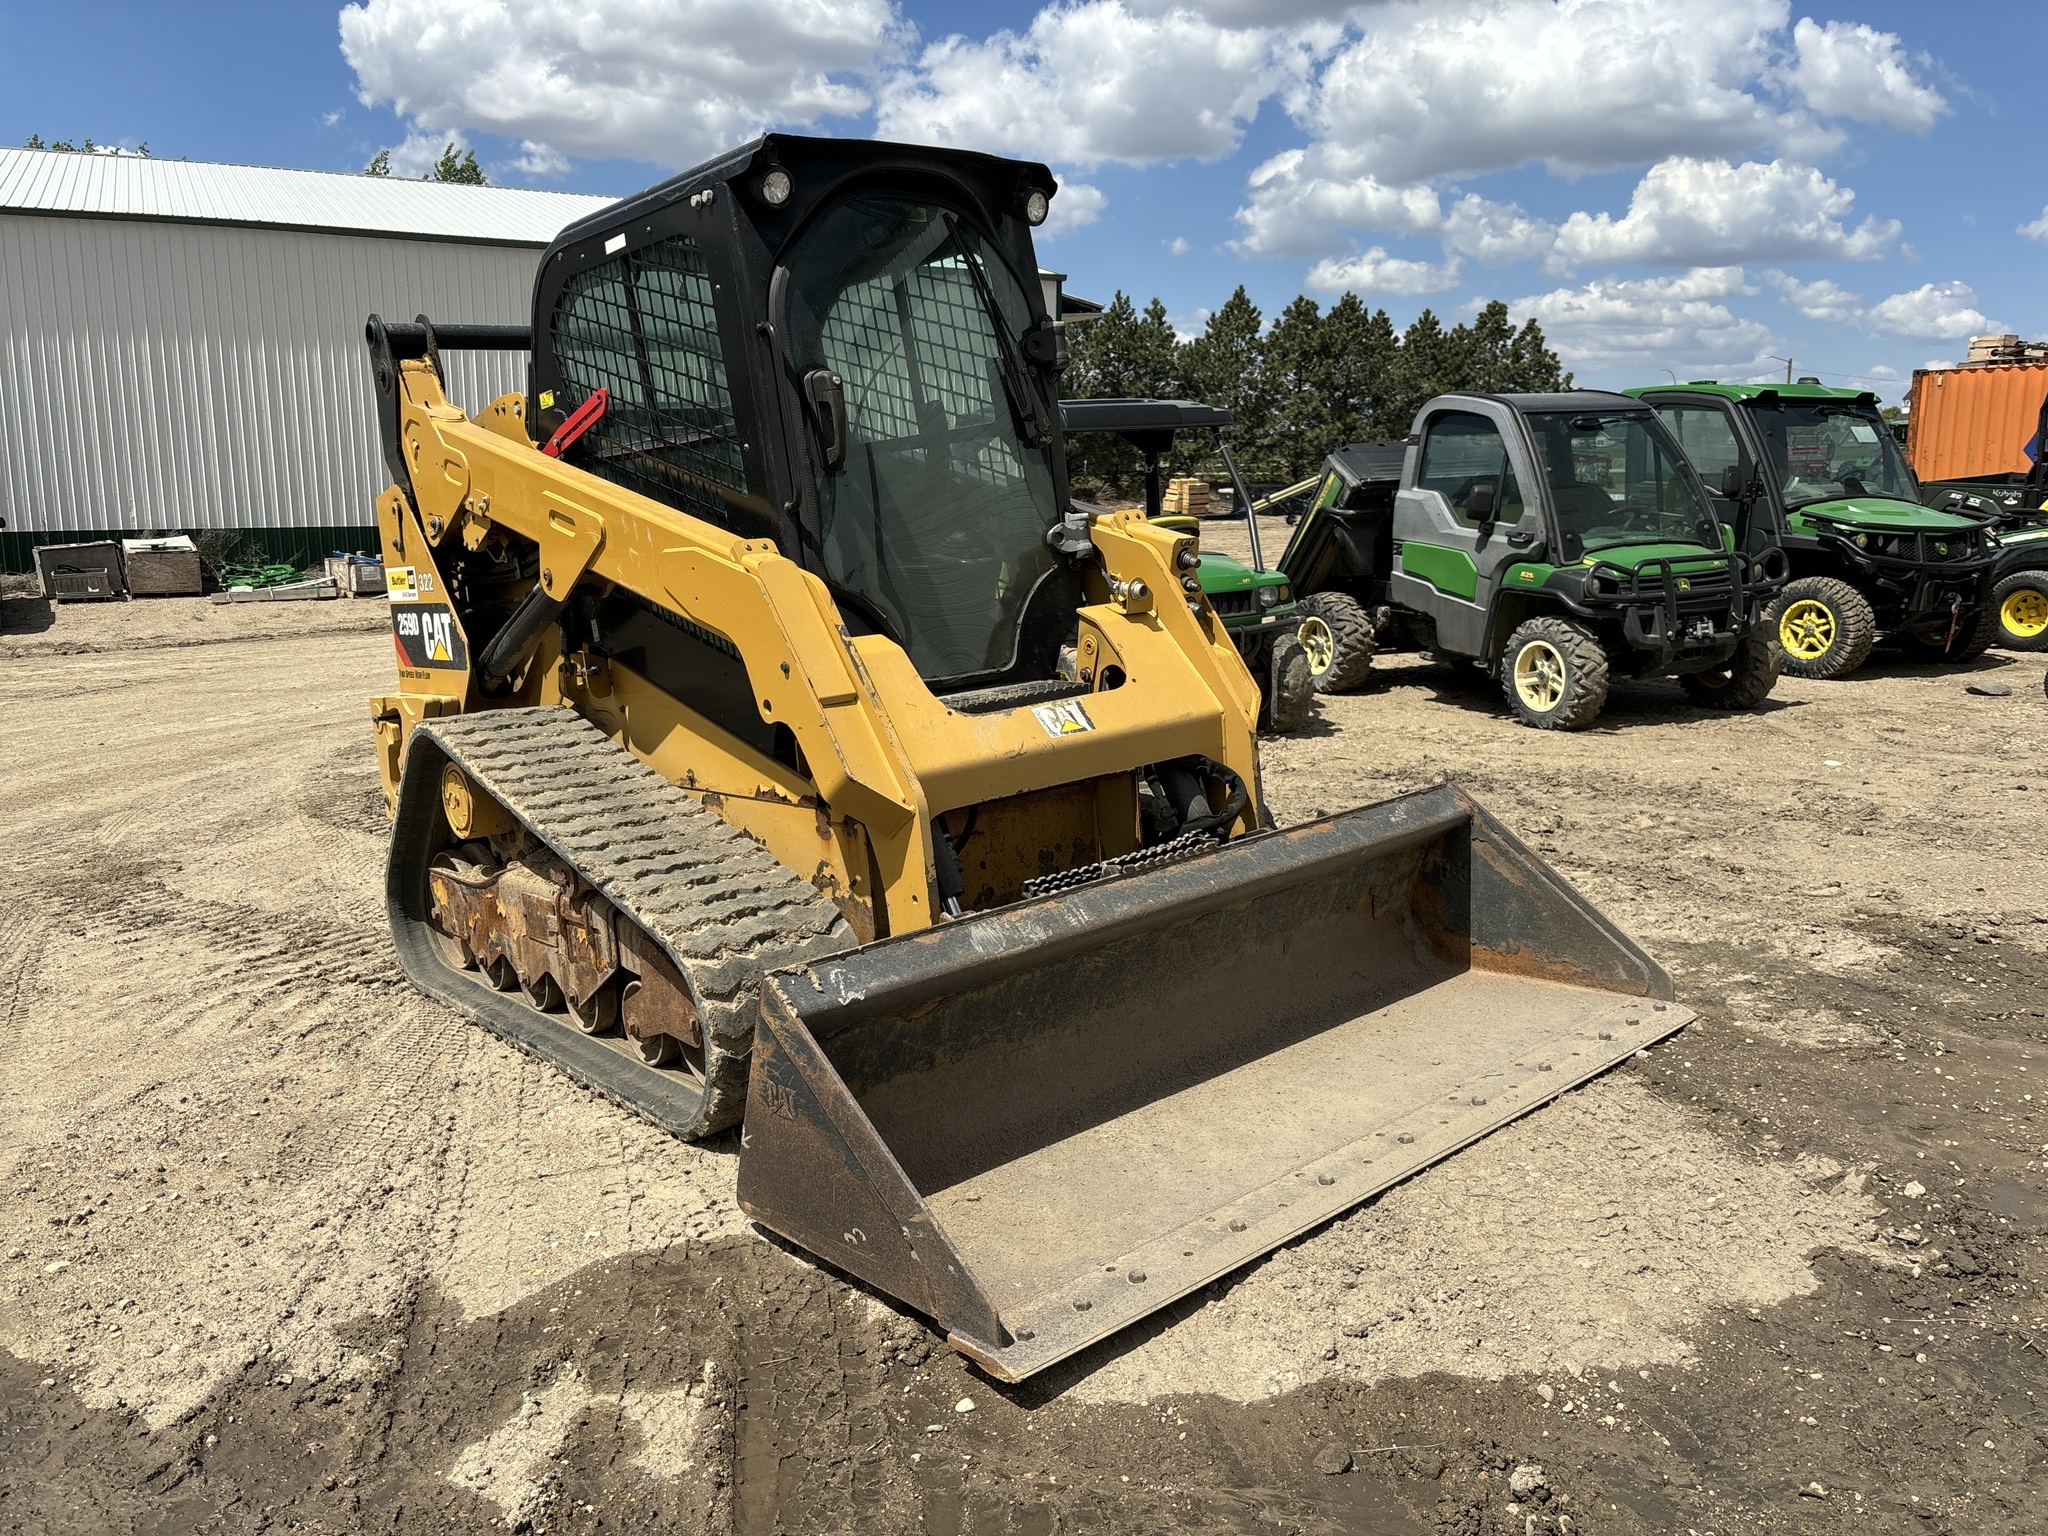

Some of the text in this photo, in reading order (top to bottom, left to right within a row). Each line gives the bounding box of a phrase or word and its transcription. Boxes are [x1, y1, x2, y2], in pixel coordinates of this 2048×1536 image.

[1992, 490, 2022, 498] Kubota
[391, 575, 406, 585] Butler
[418, 572, 434, 592] 322
[397, 612, 454, 661] 259D CAT
[1038, 700, 1093, 736] CAT
